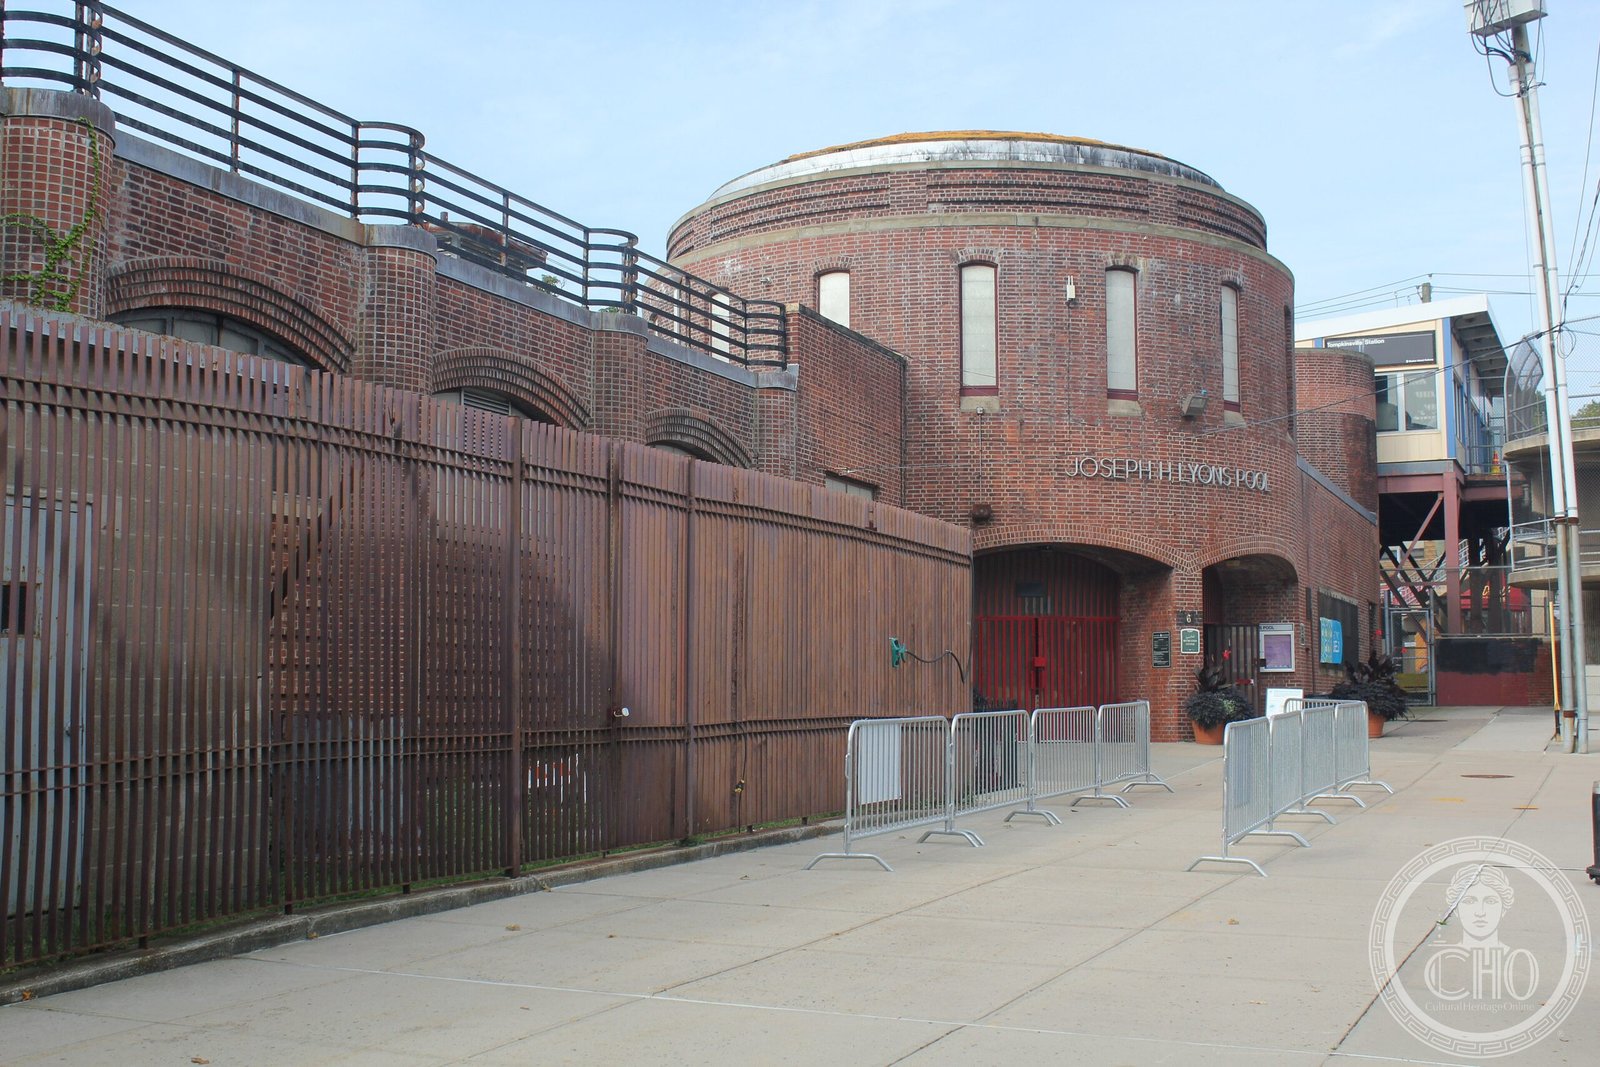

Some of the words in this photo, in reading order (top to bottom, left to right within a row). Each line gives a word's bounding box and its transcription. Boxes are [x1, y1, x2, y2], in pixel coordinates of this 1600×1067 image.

[1327, 340, 1362, 348] Tompkinsville
[1065, 457, 1151, 480] JOSEPH
[1178, 462, 1232, 487] LYONS
[1235, 467, 1271, 492] POOL
[1186, 613, 1192, 623] 6
